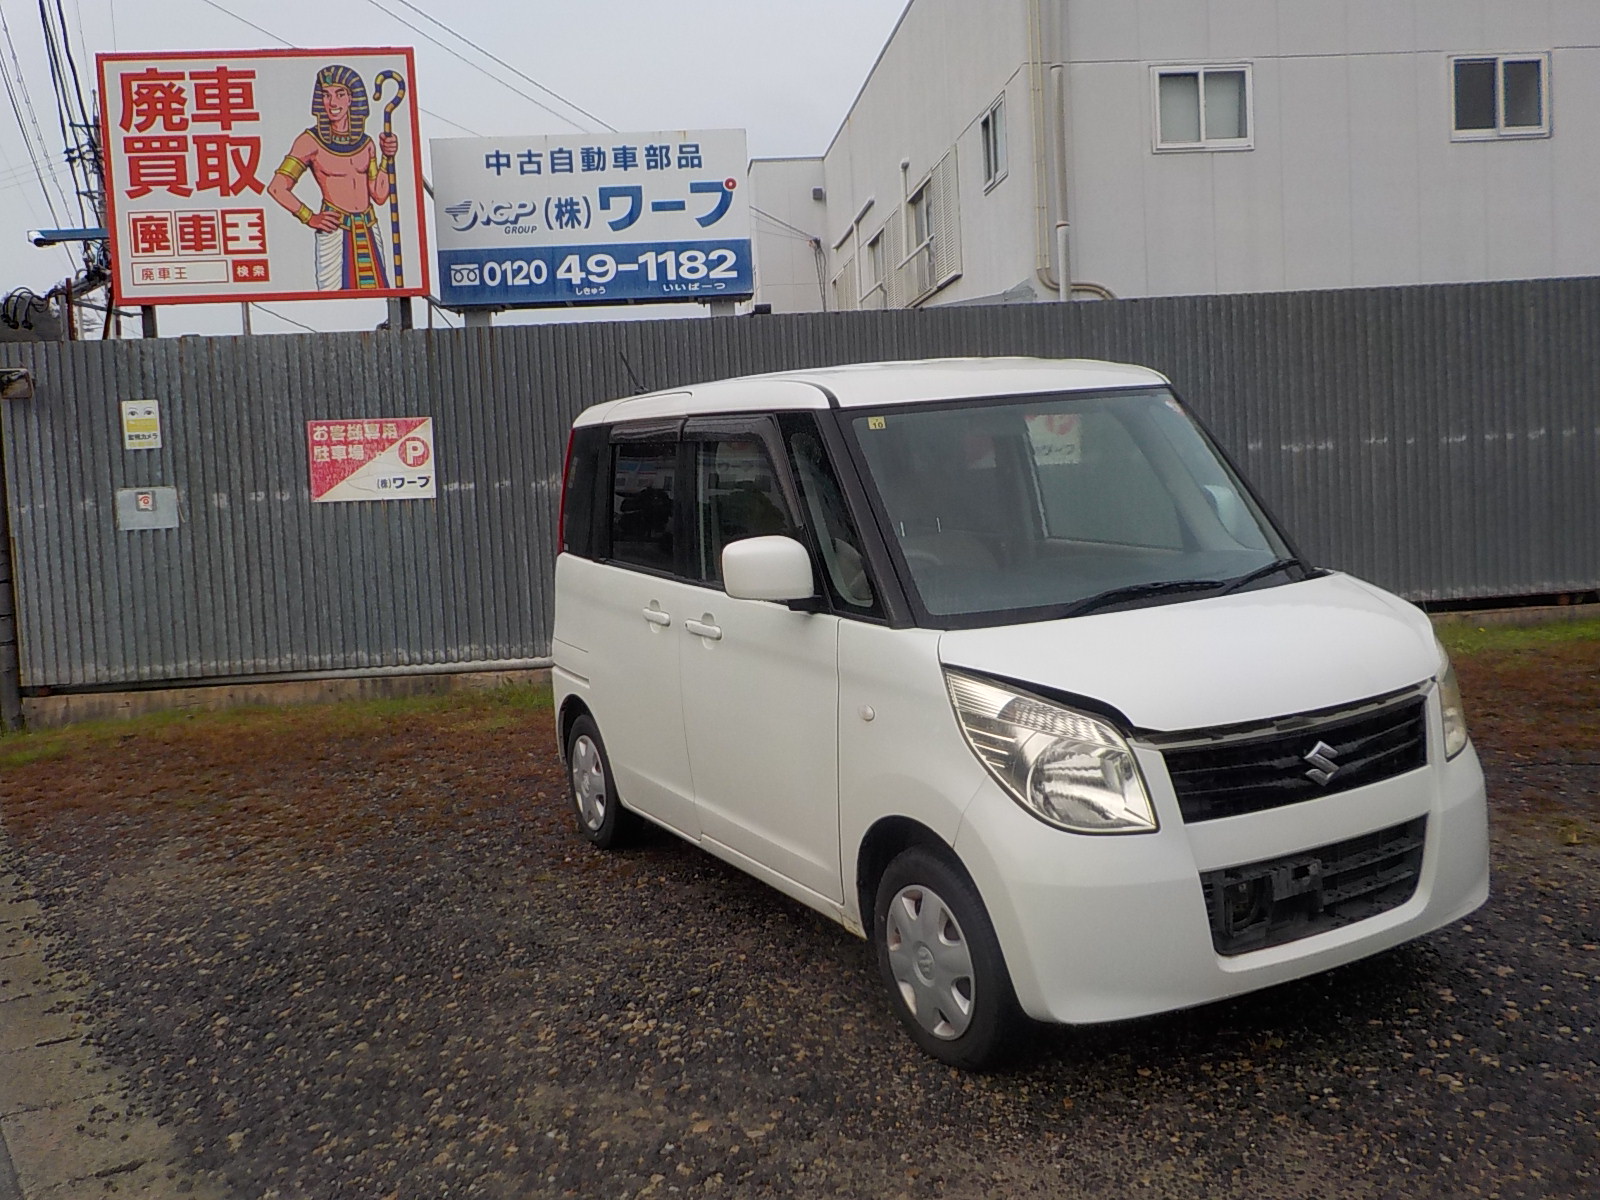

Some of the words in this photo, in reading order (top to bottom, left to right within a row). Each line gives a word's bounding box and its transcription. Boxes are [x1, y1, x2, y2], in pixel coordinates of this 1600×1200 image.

[118, 66, 260, 132] 廃車
[123, 134, 266, 199] 買取
[485, 143, 703, 176] 中古自動車部品
[504, 225, 538, 235] GROUP
[141, 266, 188, 281] 廃車王
[236, 265, 266, 277] 検索
[483, 259, 547, 286] 0120
[556, 249, 738, 285] 49-1182
[312, 423, 399, 441] お客様専用
[313, 444, 365, 462] 駐車場
[406, 441, 425, 465] P
